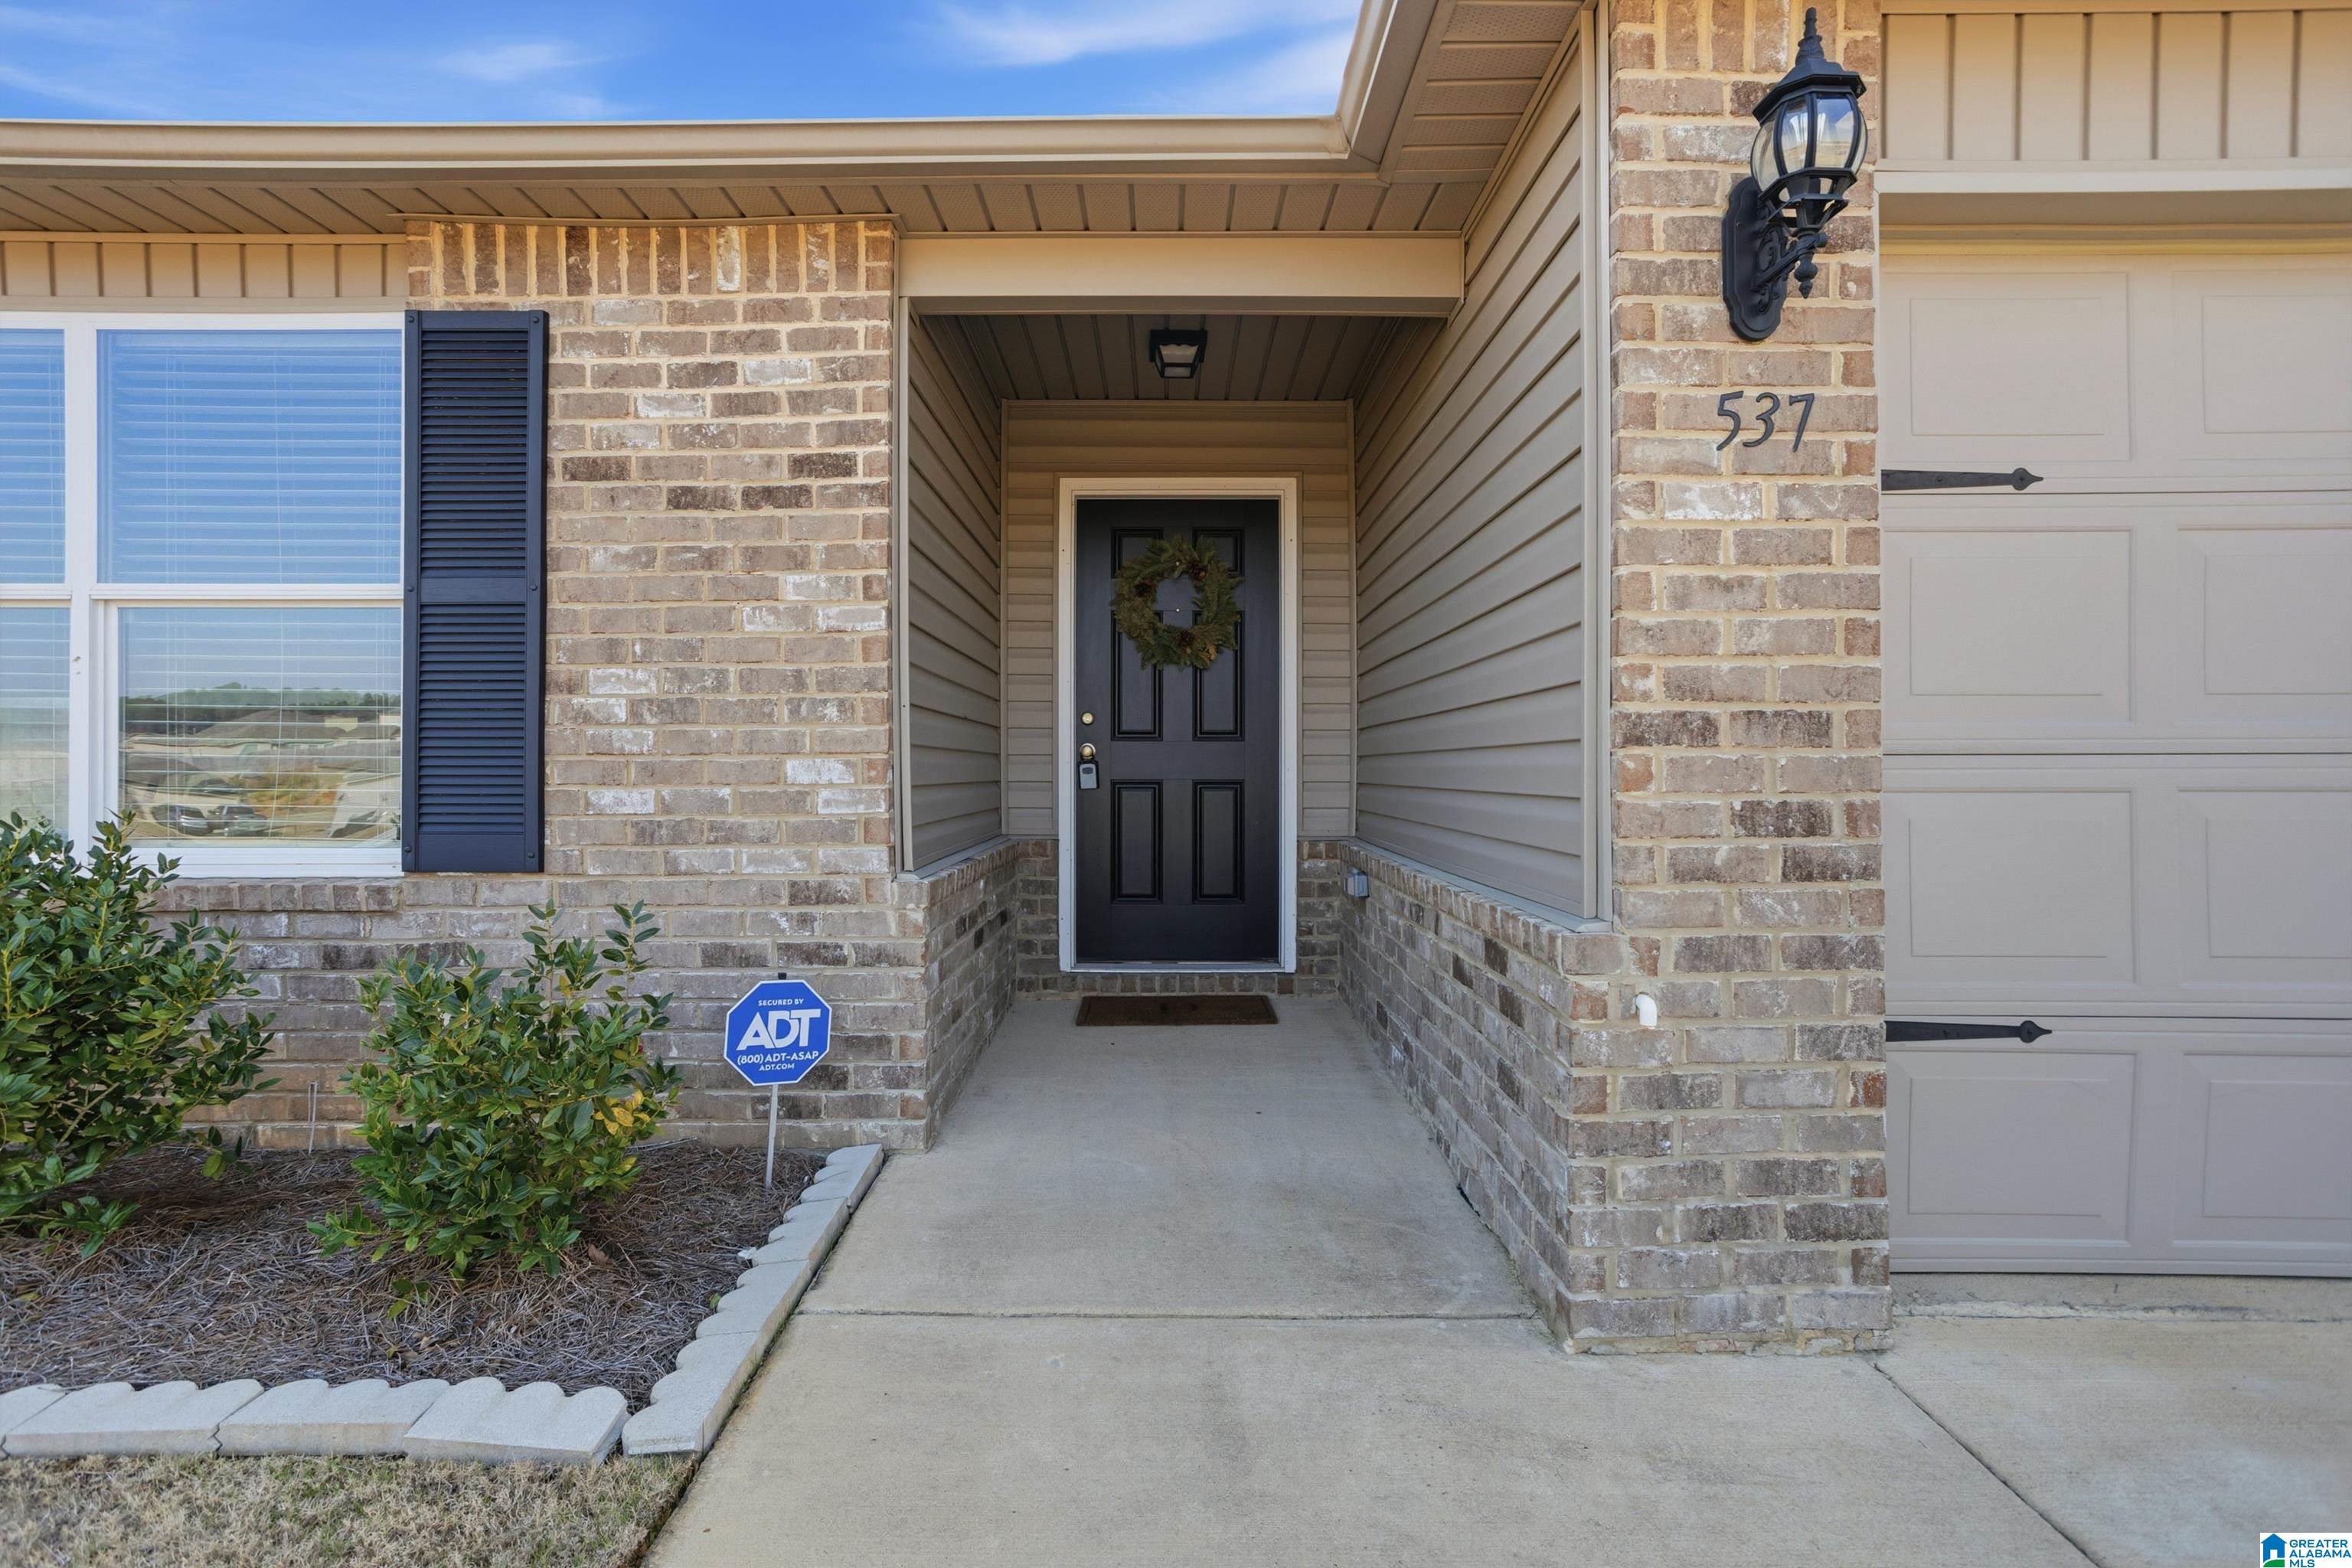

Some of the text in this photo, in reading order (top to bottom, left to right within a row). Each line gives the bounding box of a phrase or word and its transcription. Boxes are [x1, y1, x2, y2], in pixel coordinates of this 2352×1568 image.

[1717, 390, 1815, 452] 537
[736, 1009, 821, 1050] ADT
[737, 1051, 819, 1065] (800) ADT-ASAP
[759, 1063, 795, 1071] ADT.COM
